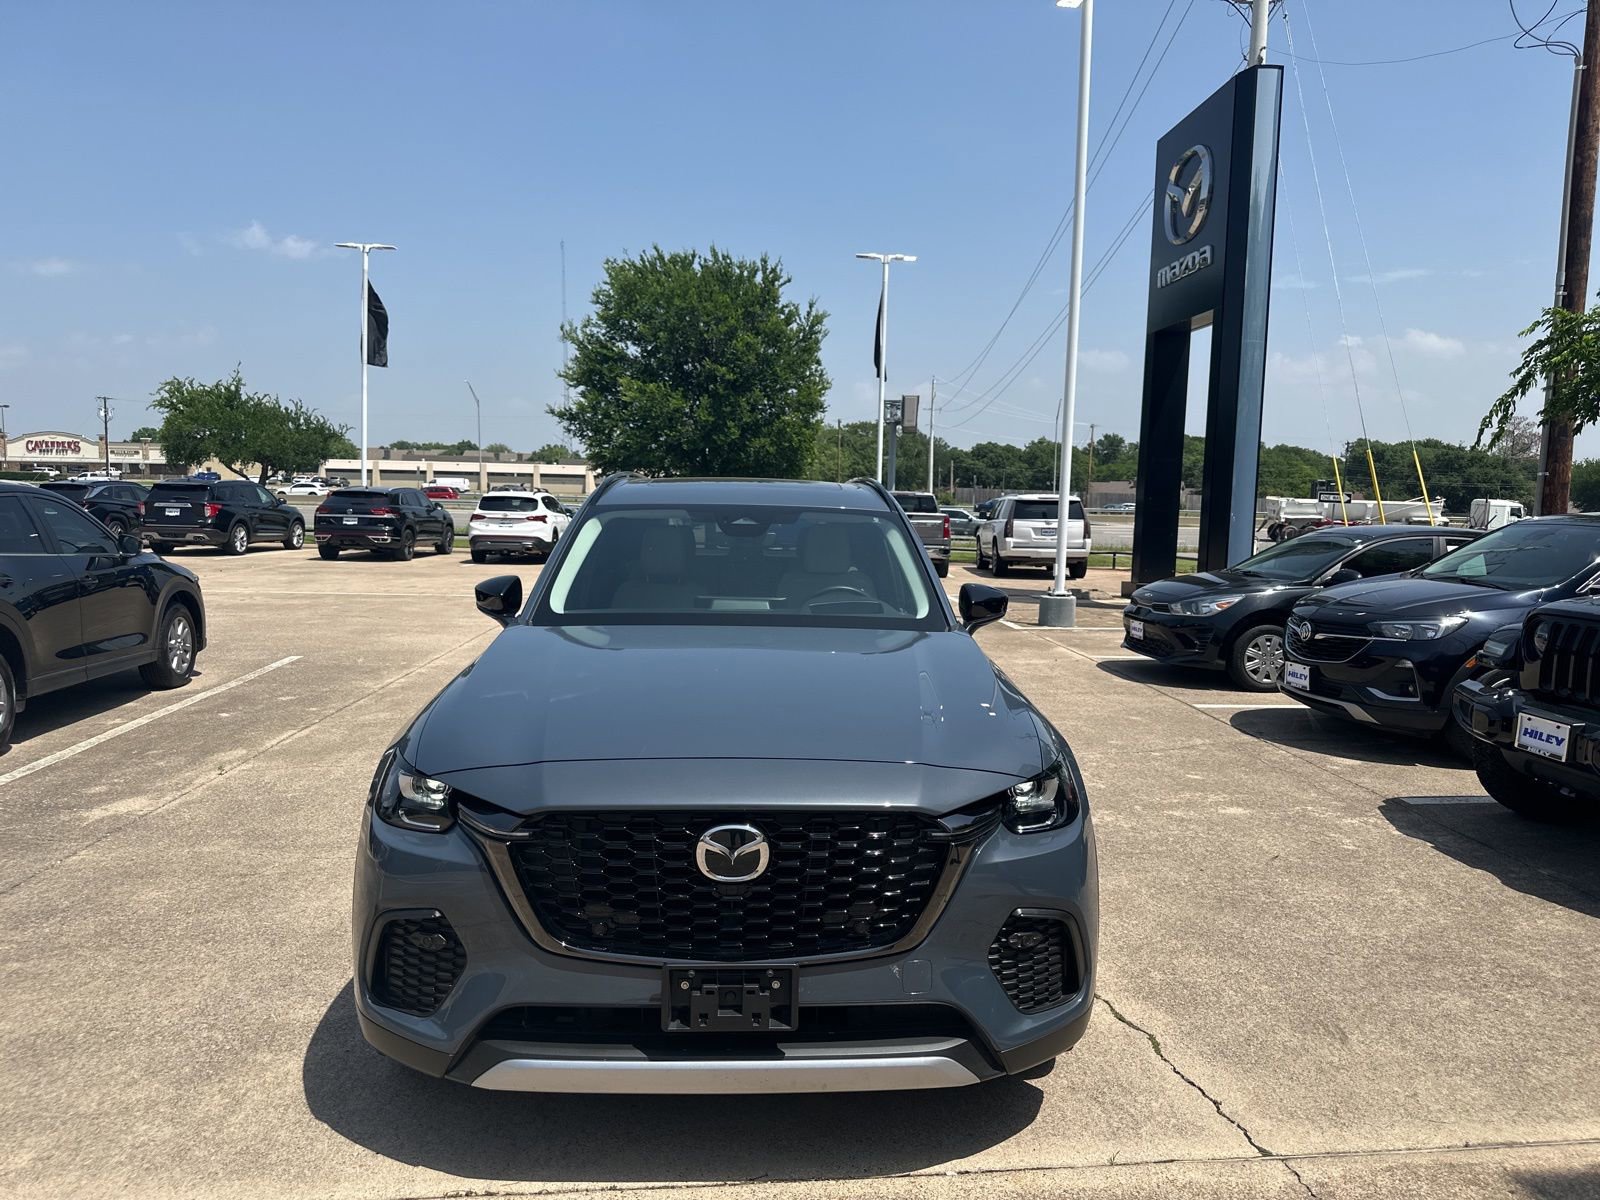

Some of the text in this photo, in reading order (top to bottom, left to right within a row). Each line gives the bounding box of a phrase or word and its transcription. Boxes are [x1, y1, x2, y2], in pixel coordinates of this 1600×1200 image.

[26, 440, 81, 453] CAVENDER'S
[1288, 670, 1308, 681] HILEY
[1522, 727, 1566, 747] HILEY
